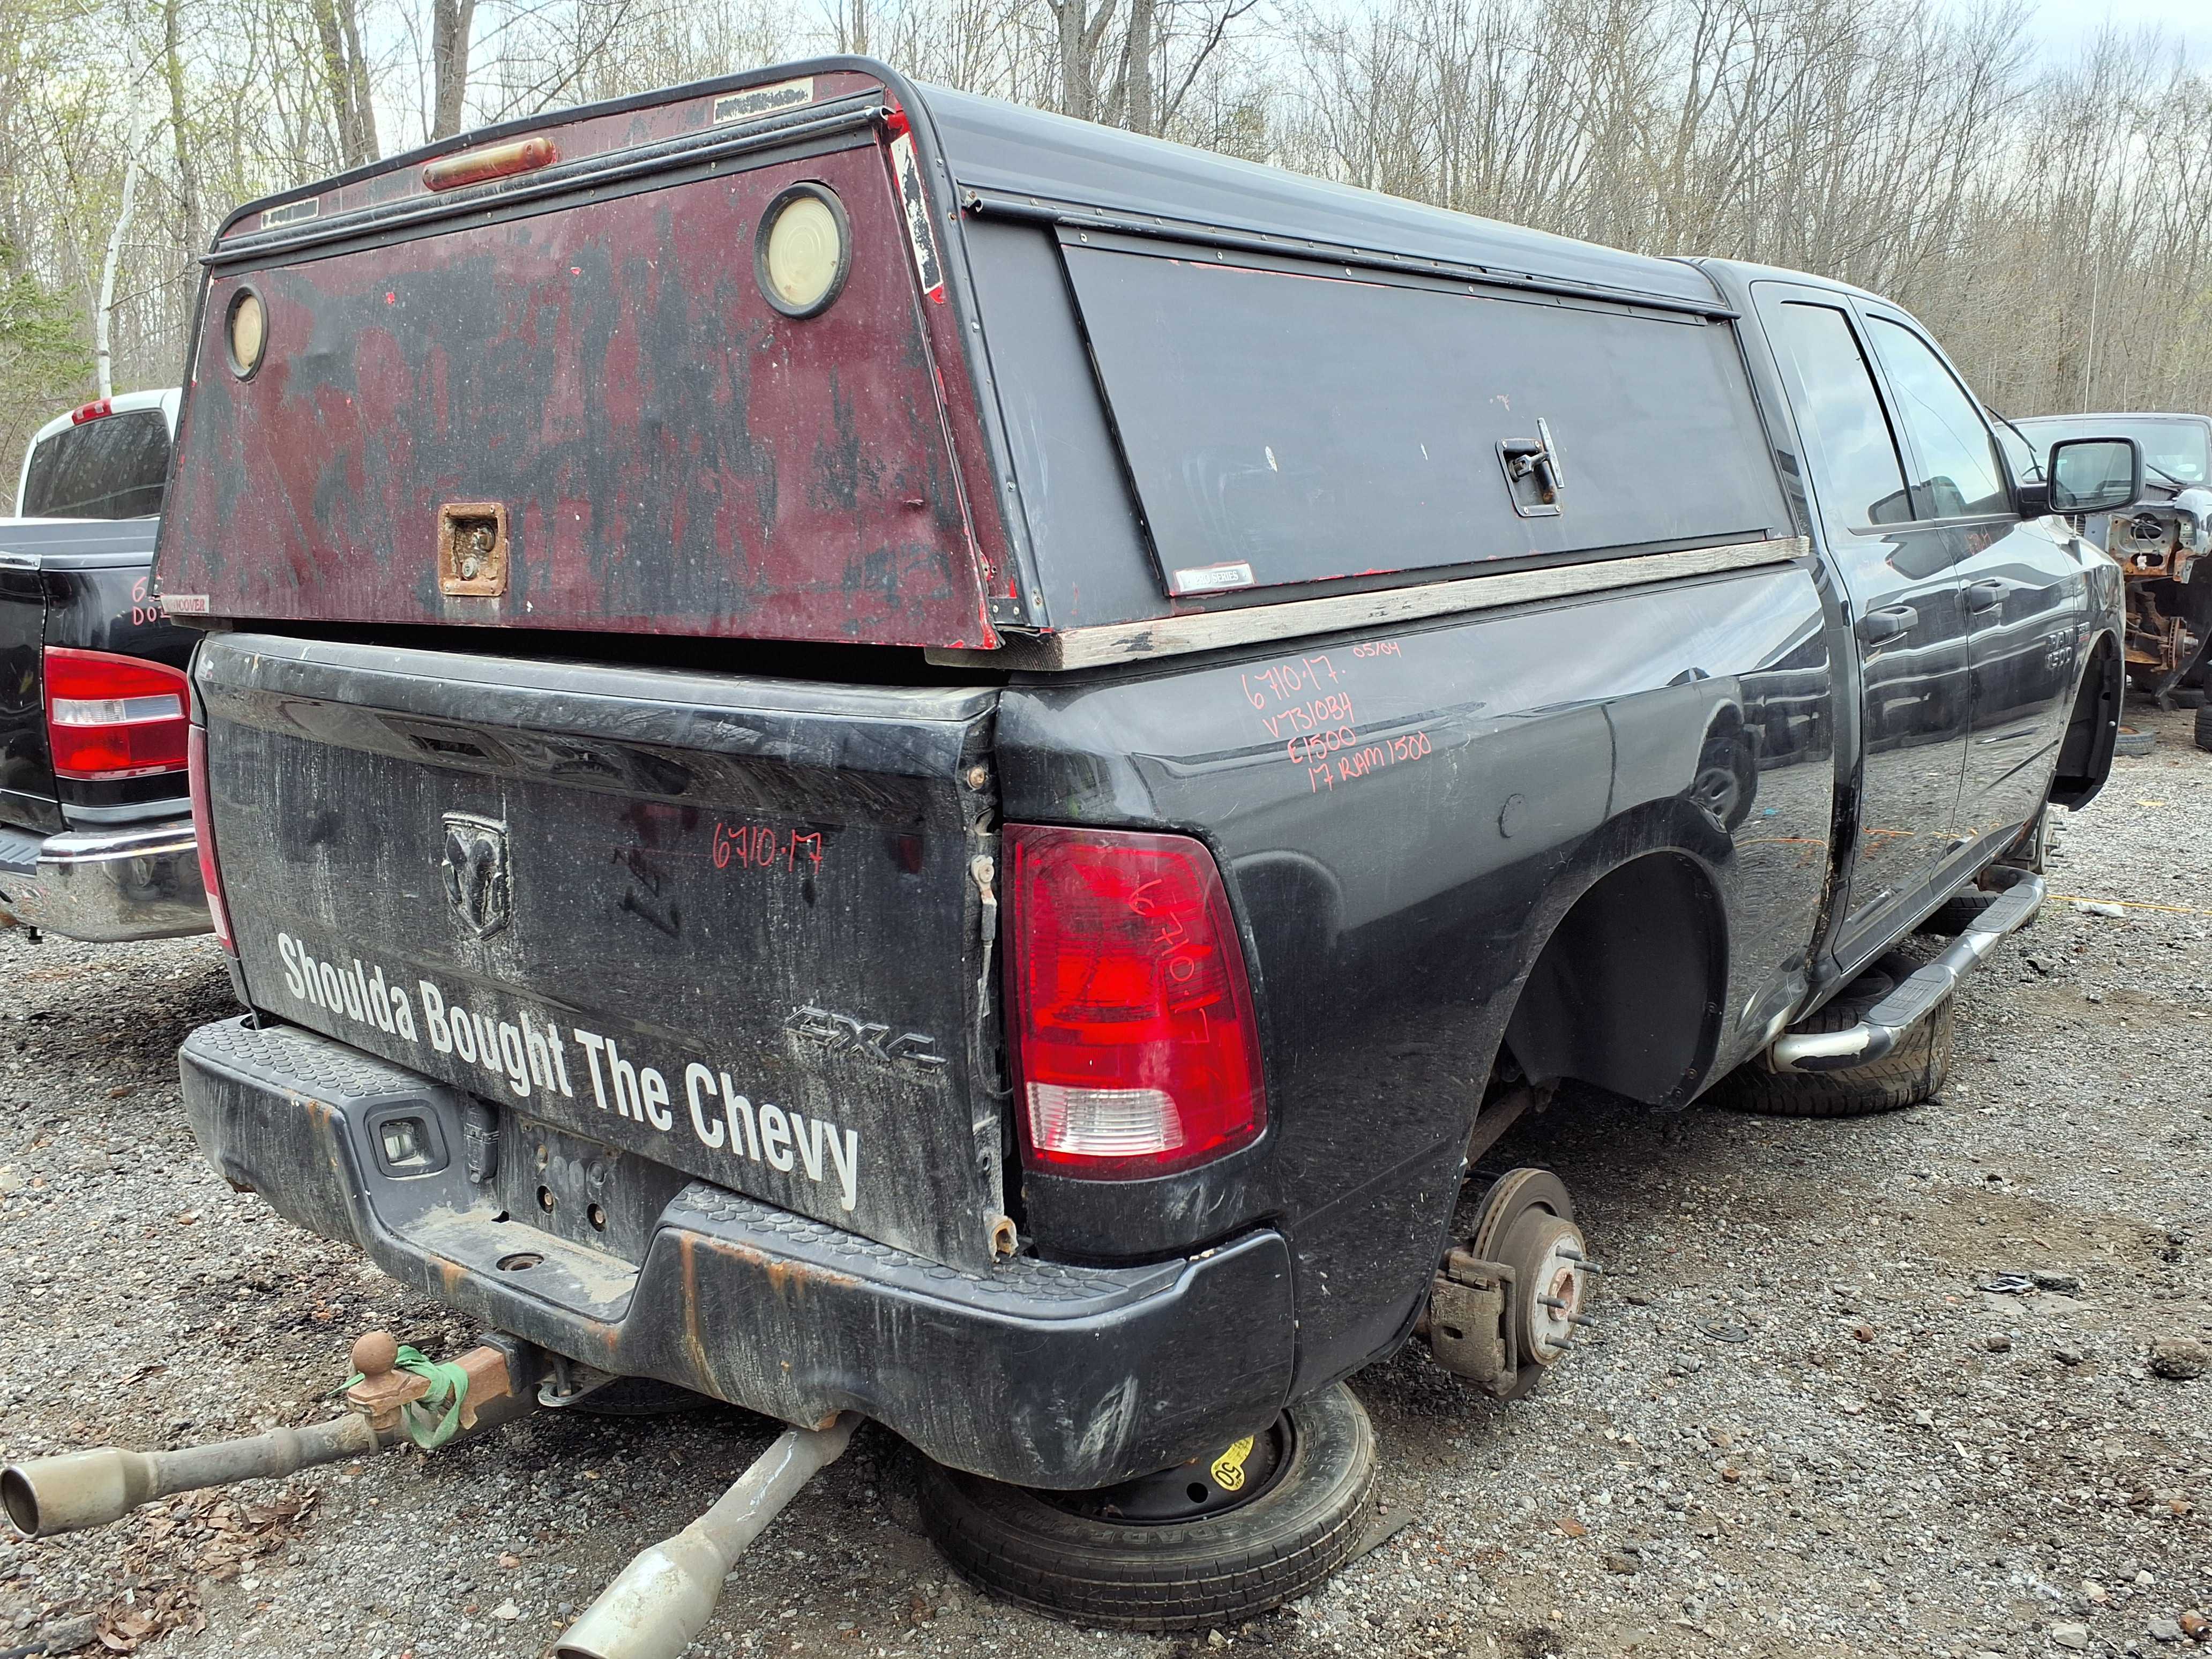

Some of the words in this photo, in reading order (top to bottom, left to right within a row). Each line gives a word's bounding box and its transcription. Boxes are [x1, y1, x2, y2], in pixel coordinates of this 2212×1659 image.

[1212, 571, 1239, 583] SERIES
[165, 599, 205, 611] ICOVER
[1339, 747, 1386, 781] RAM
[1386, 730, 1432, 765] 1500
[278, 931, 419, 1043] Shoulda
[419, 980, 573, 1097] Bought
[574, 1028, 672, 1131] The
[685, 1063, 858, 1211] Chevy
[1215, 1462, 1242, 1487] 50
